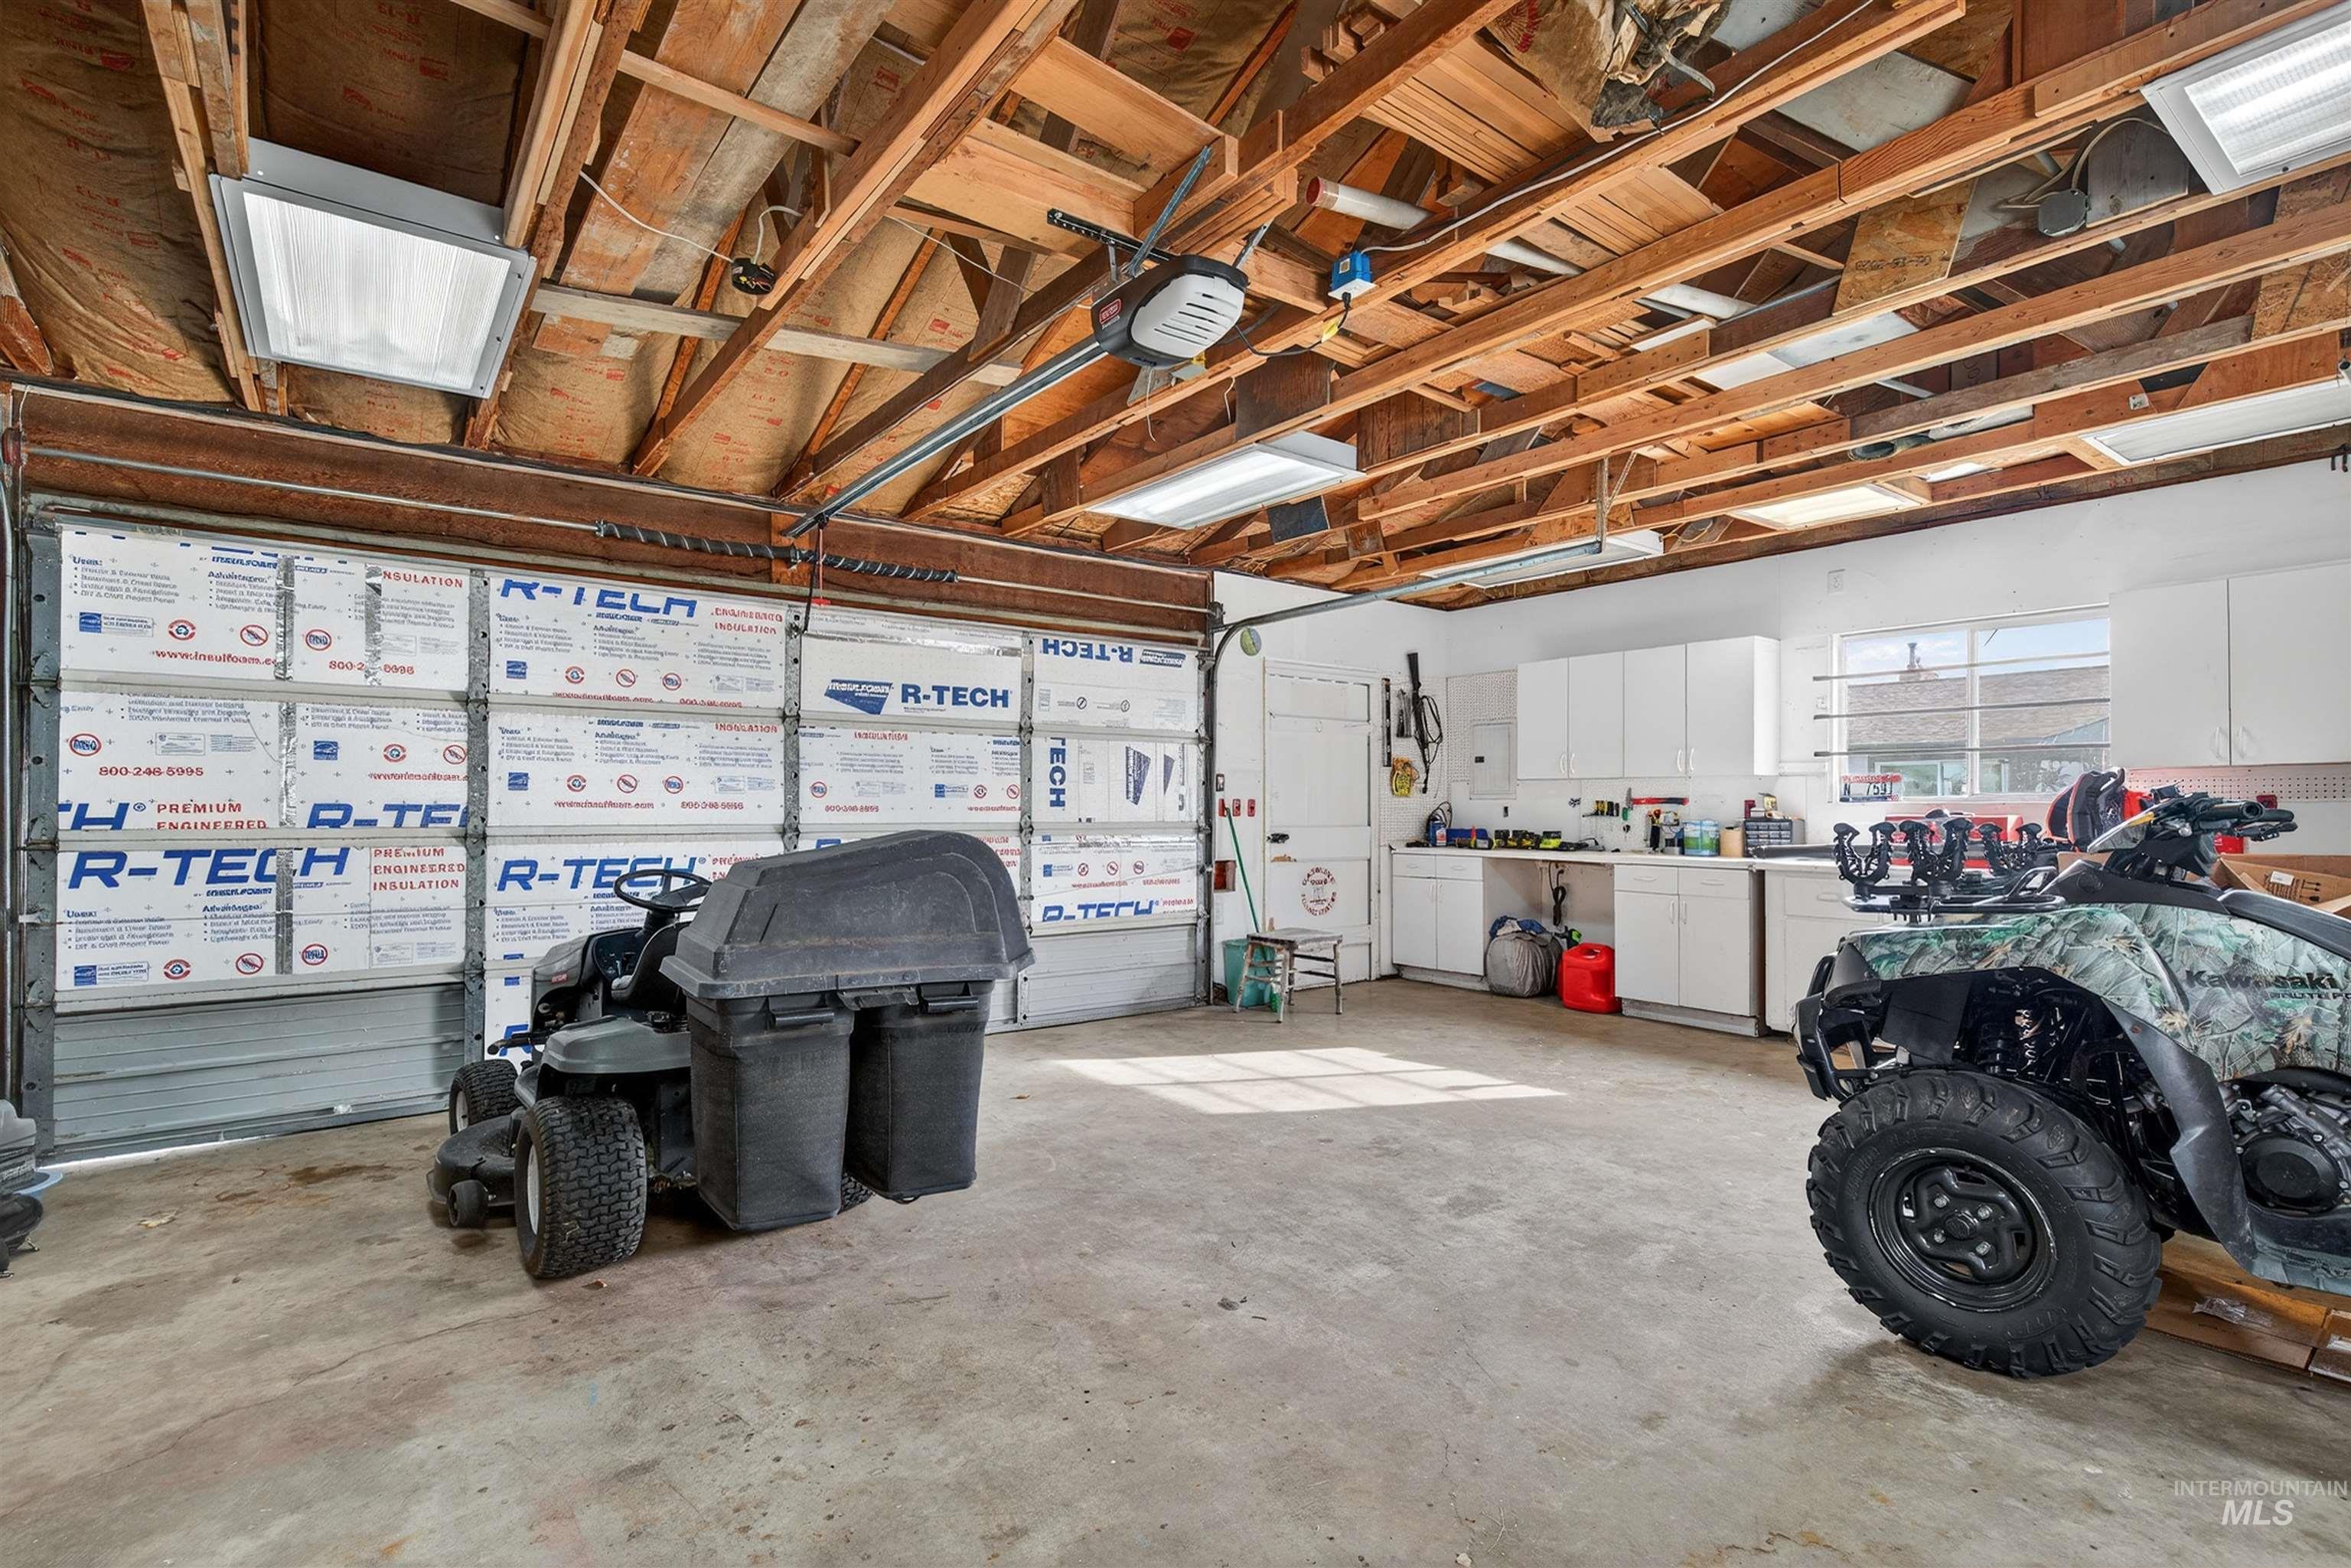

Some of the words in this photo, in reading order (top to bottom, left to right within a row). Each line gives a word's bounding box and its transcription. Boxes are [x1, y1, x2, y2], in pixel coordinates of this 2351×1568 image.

[382, 571, 463, 588] NSULATION
[1042, 638, 1133, 663] R-TECH
[901, 683, 1009, 709] R-TECH
[157, 804, 243, 814] PREMIUM
[157, 820, 268, 830] ENGINEERED
[373, 847, 445, 858] PREMIUM
[373, 863, 466, 875] ENGINEERED
[373, 879, 459, 892] INSULATION
[2185, 970, 2340, 989] Kawasaki
